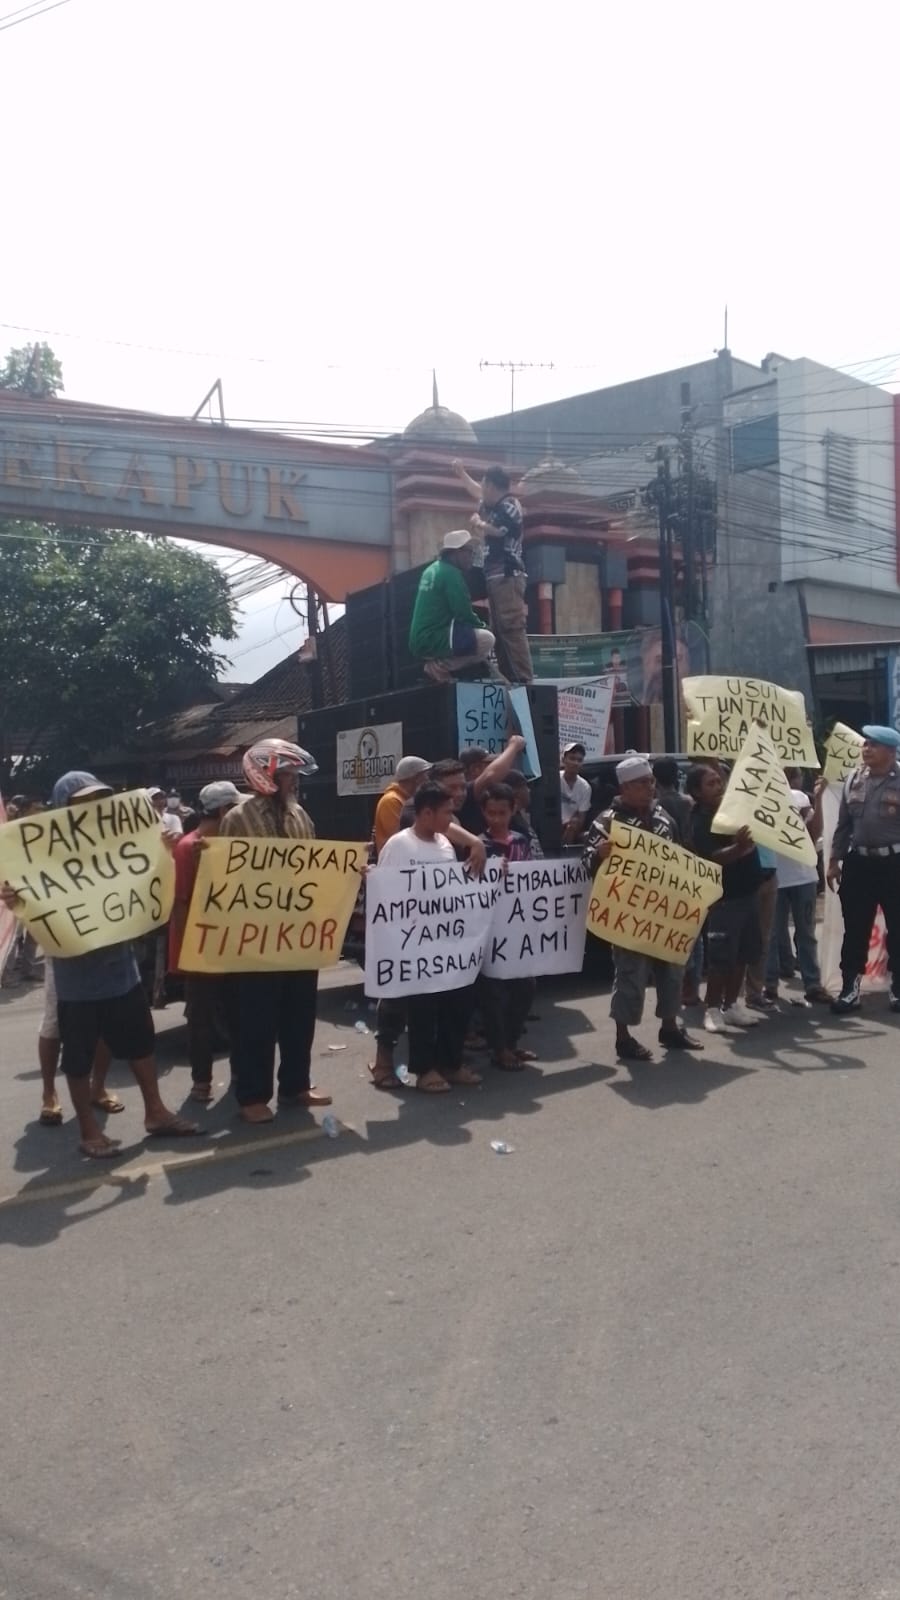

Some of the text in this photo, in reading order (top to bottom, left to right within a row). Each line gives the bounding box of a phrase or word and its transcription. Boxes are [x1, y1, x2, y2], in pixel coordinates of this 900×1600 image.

[727, 679, 779, 701] USUT
[696, 696, 787, 724] TUNTAN
[20, 809, 96, 864] PAK
[615, 826, 680, 864] JAKSA
[15, 841, 150, 901] HARUS
[226, 840, 361, 876] BUNGKAR
[30, 876, 162, 948] TEGAS
[204, 882, 318, 912] KASUS
[508, 894, 582, 924] ASET
[607, 876, 701, 925] KEPADA
[195, 918, 338, 956] TIPIKOR
[400, 919, 465, 950] YANG
[588, 898, 664, 943] RAKYAT
